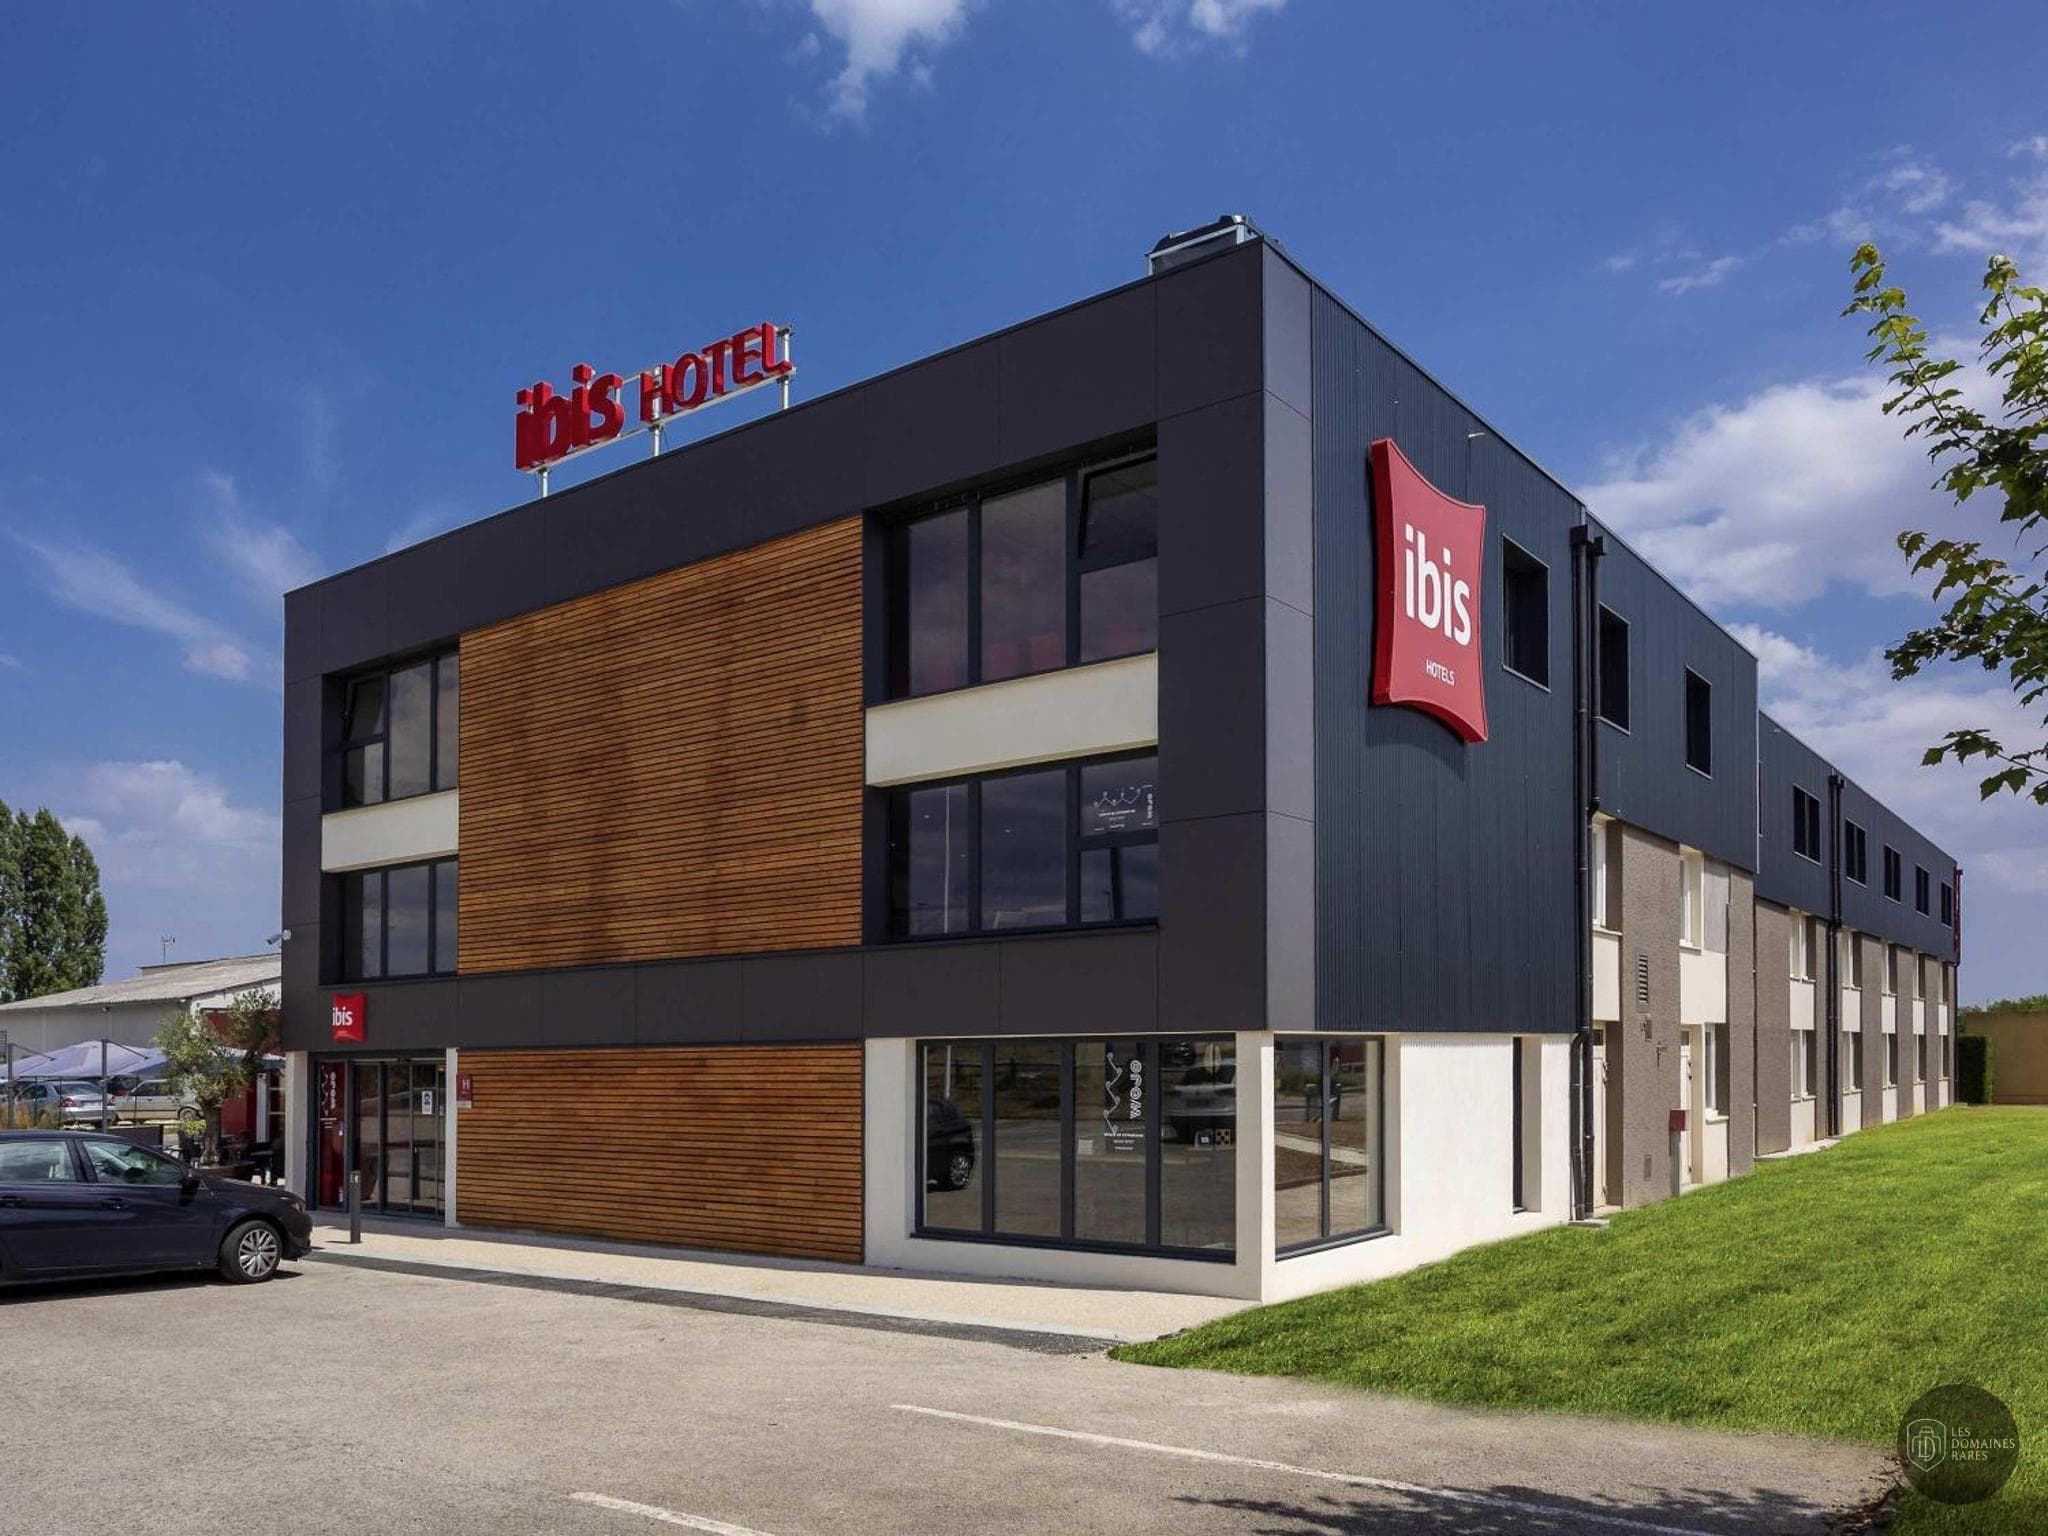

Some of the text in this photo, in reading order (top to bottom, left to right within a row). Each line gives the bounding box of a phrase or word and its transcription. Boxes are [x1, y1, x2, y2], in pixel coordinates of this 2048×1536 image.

[516, 321, 792, 470] ibis HOTEL
[1405, 523, 1471, 646] ibis
[1426, 658, 1455, 686] HOTELS
[332, 1006, 353, 1026] ibis
